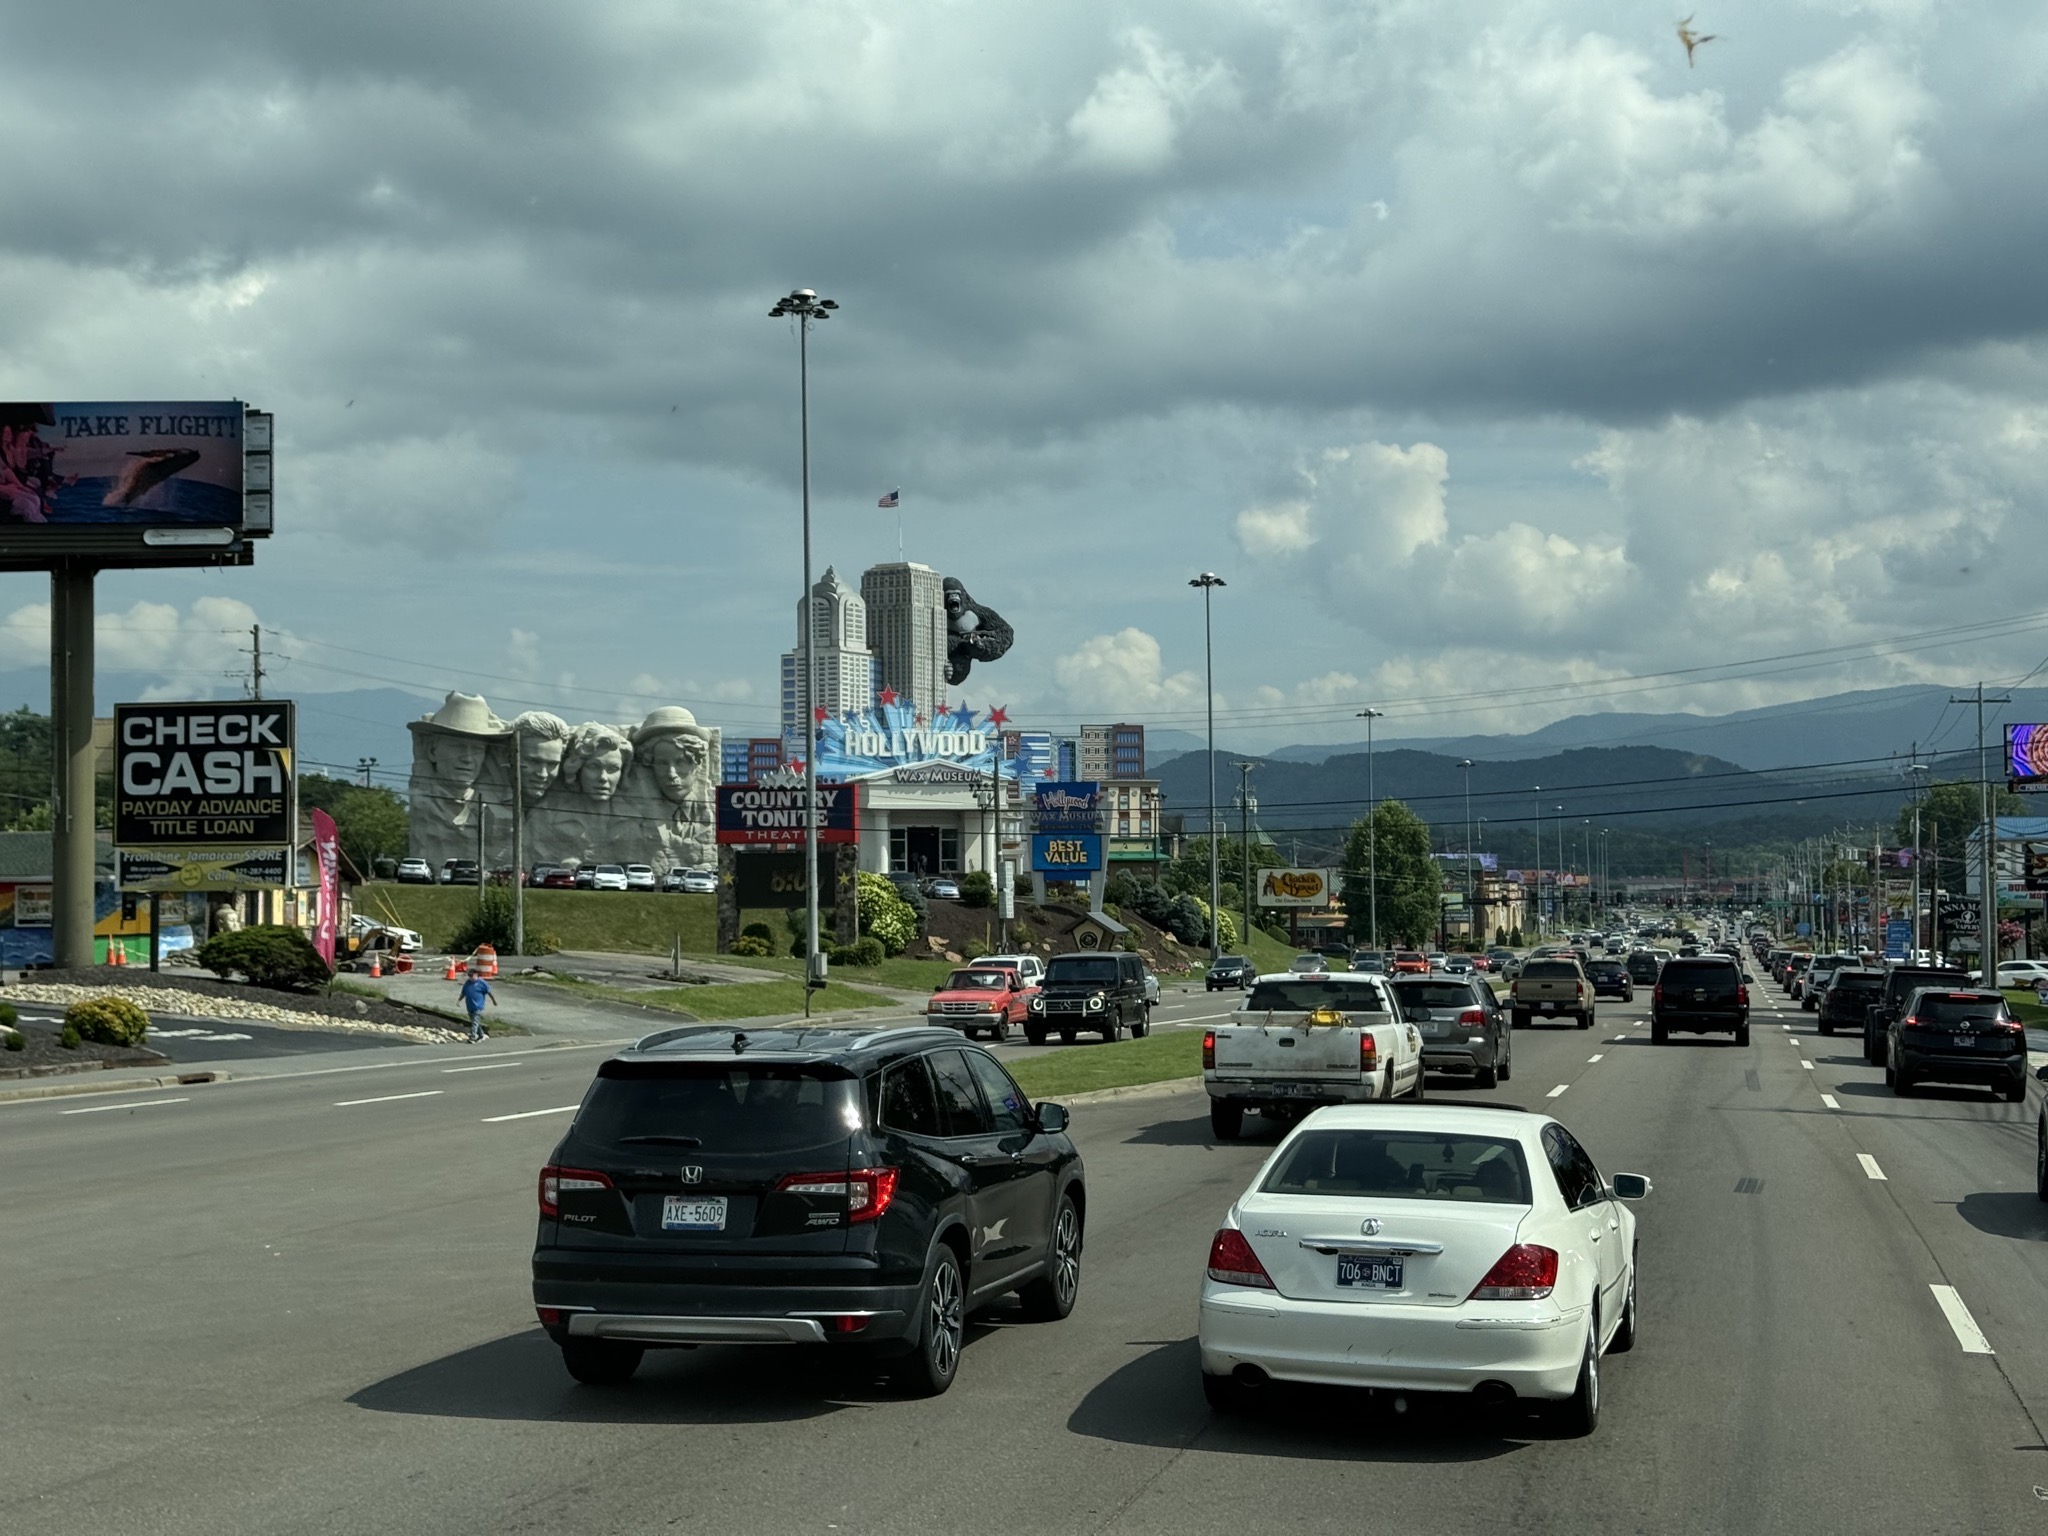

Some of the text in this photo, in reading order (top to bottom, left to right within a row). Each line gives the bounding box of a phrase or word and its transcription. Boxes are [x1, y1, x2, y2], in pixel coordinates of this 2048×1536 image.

[61, 415, 237, 439] TAKE FLIGHT!
[123, 714, 281, 746] CHECK
[845, 729, 987, 757] HOLLYWOOD
[122, 751, 282, 796] CASH
[931, 768, 982, 783] MUSEUM
[122, 799, 283, 816] PAYDAY ADVANCE
[149, 819, 255, 835] TITLE LOAN
[745, 830, 826, 840] THEATE
[1049, 840, 1083, 853] BEST
[244, 849, 283, 862] STORE
[1044, 851, 1088, 863] VALUE
[1939, 902, 1966, 915] ANNA
[563, 1213, 598, 1223] PILOT
[666, 1205, 724, 1222] AXE-5609
[804, 1217, 841, 1226] AWD
[1340, 1262, 1401, 1282] 706 BNCT
